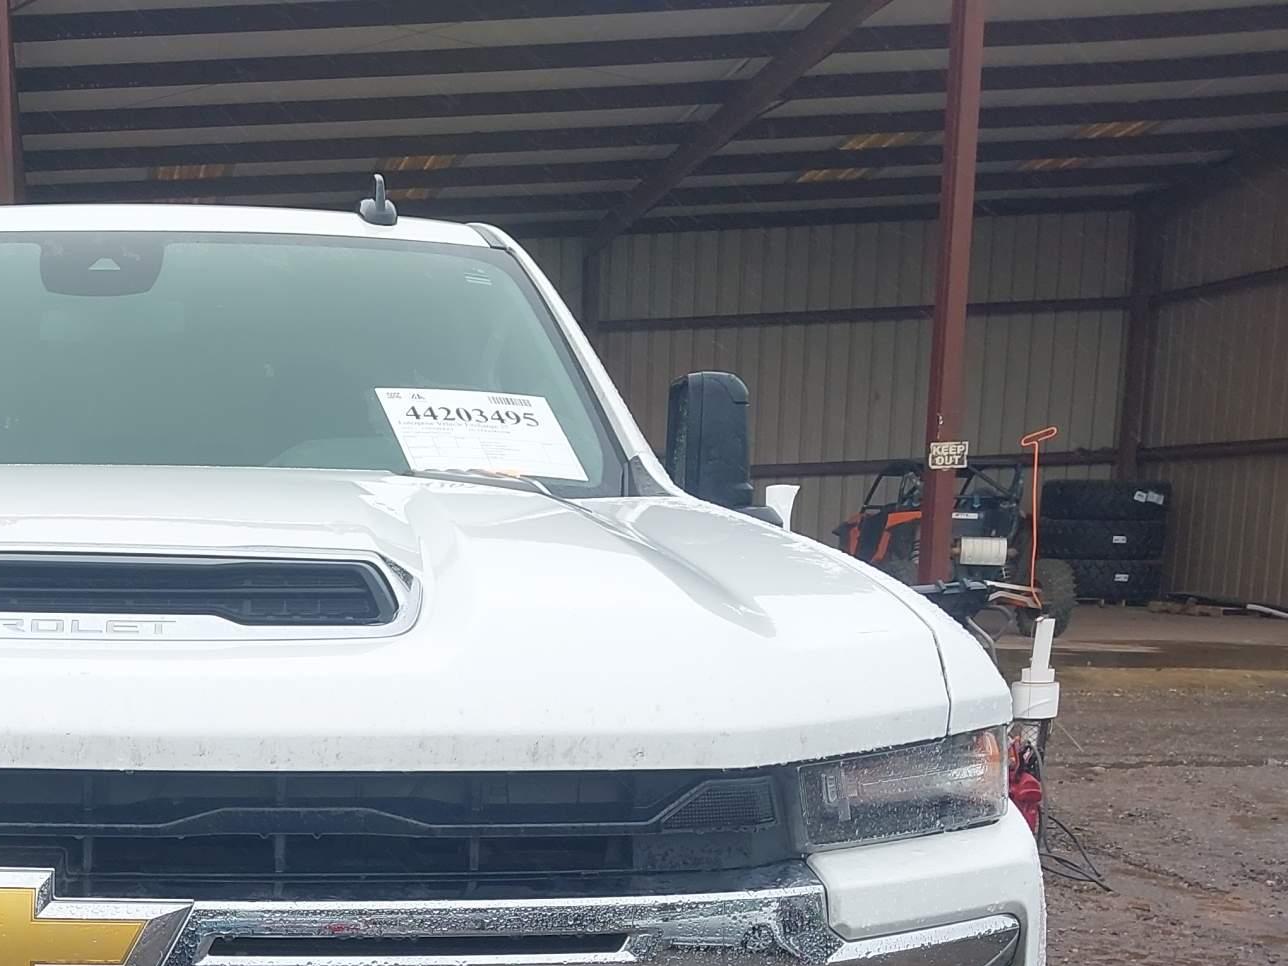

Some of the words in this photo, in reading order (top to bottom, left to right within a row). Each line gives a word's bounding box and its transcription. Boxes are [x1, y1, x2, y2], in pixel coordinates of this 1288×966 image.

[405, 405, 540, 427] 44203495
[933, 445, 965, 456] KEEP
[935, 455, 961, 465] OUT
